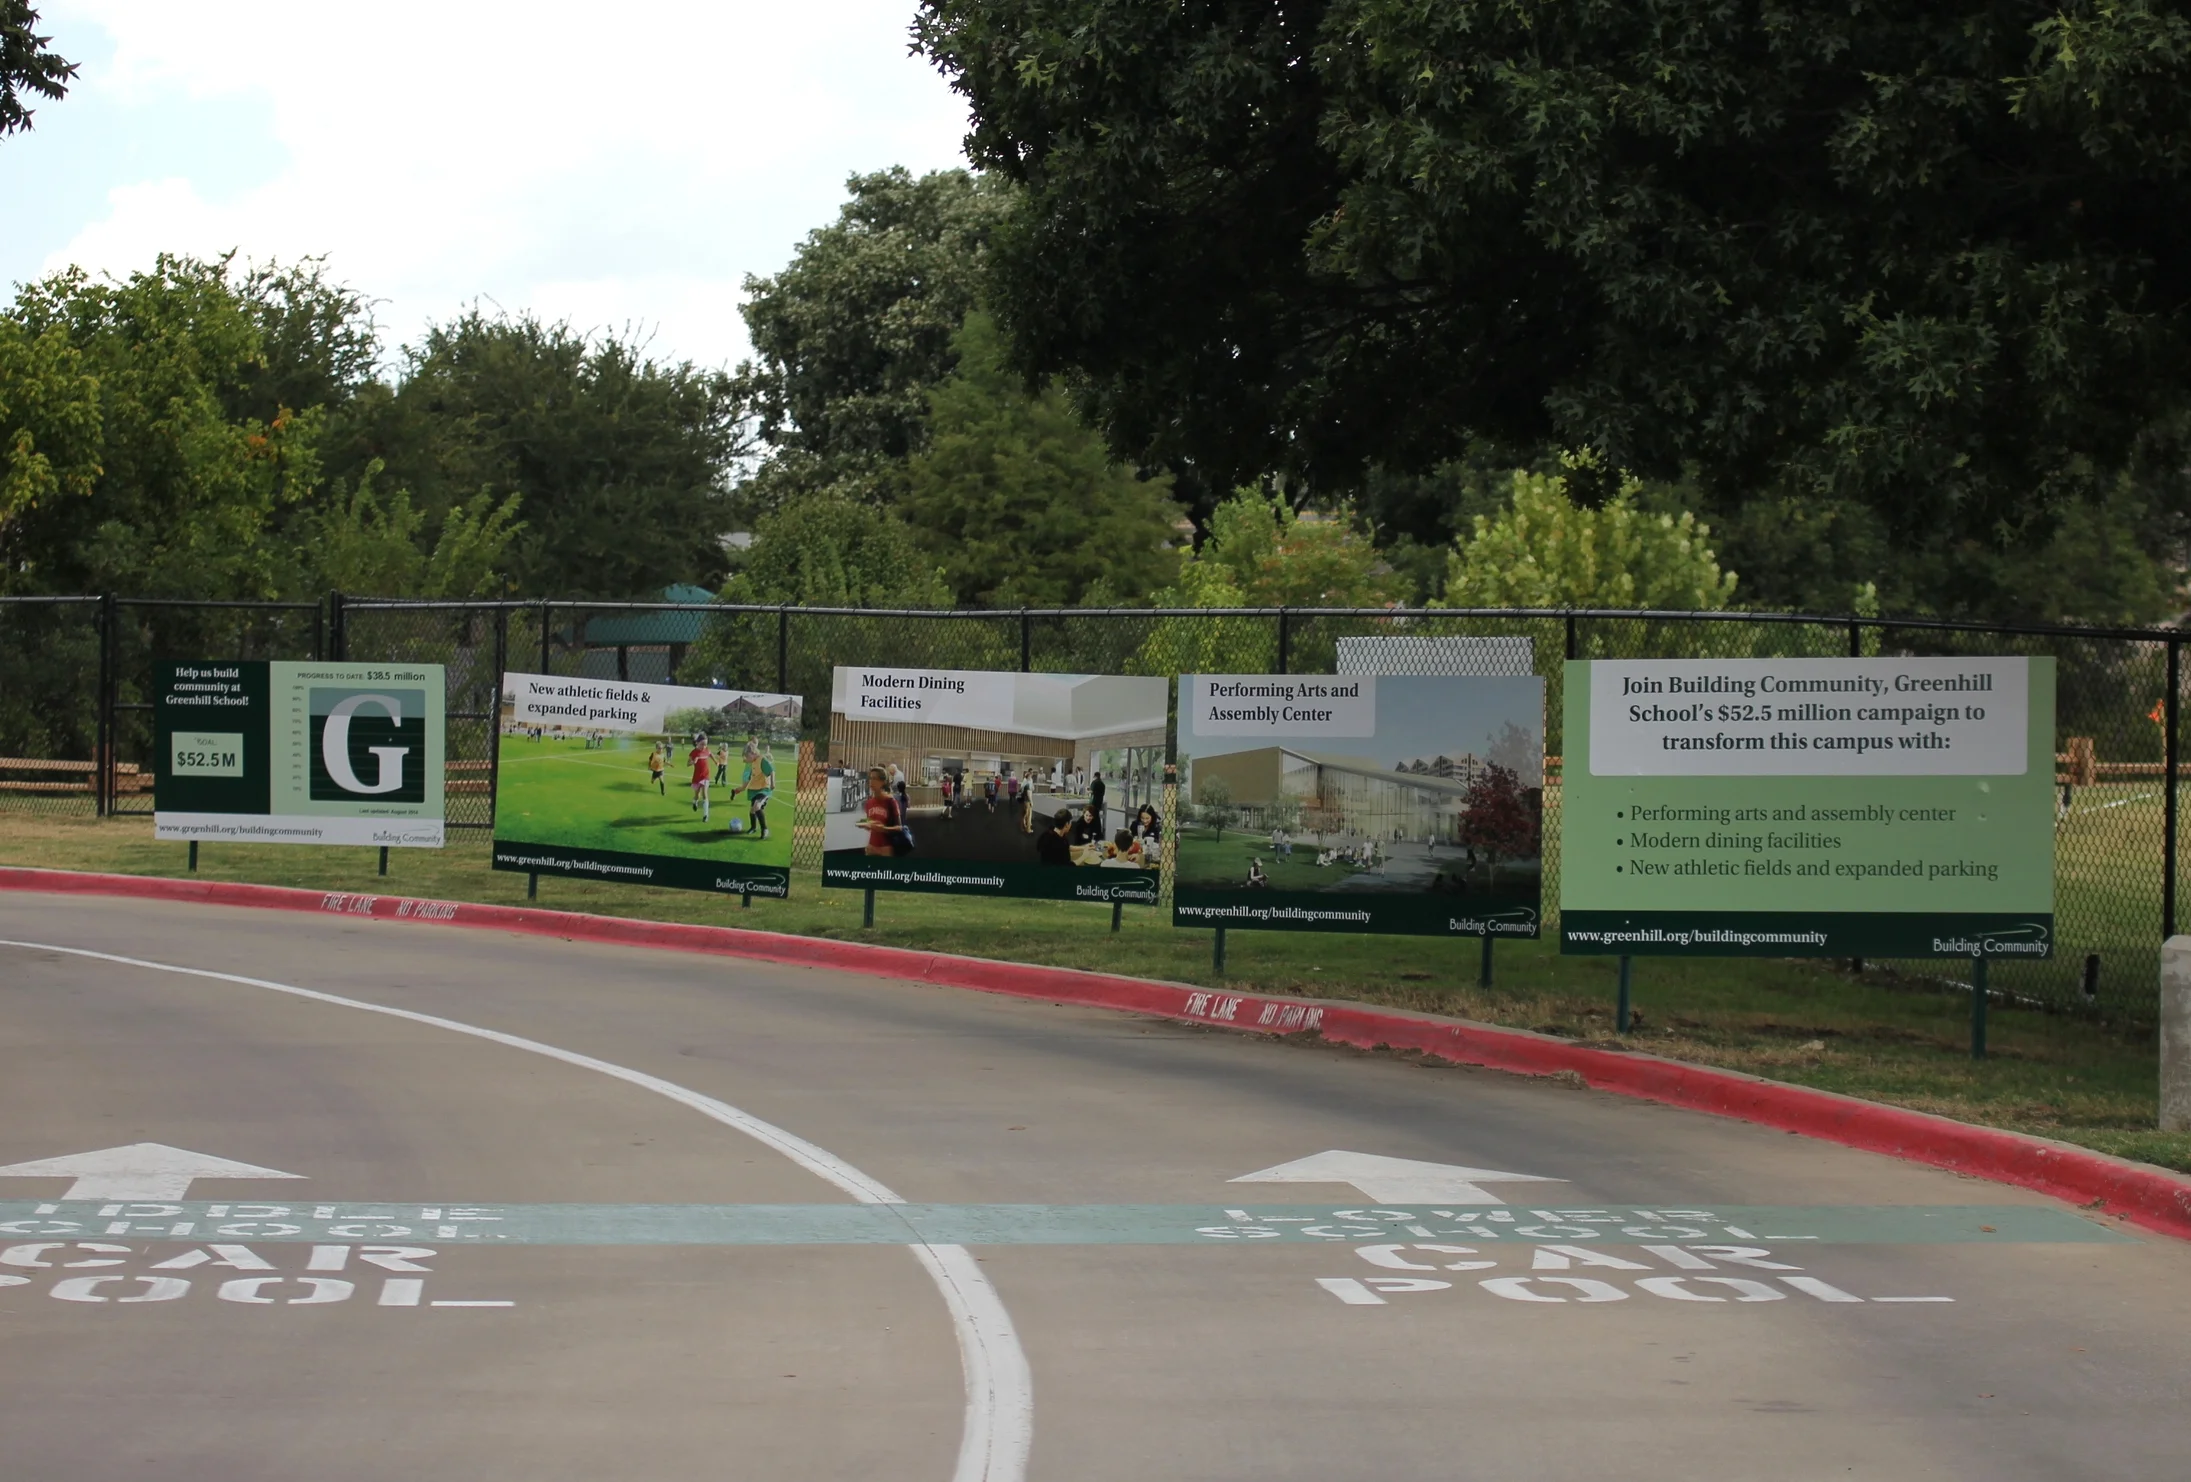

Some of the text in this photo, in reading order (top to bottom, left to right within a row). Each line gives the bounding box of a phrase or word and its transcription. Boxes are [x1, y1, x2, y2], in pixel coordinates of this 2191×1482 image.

[175, 667, 239, 680] Help us build
[367, 671, 391, 681] $38.5
[394, 672, 426, 681] million
[862, 674, 965, 693] Modern Dining
[173, 682, 241, 694] community at
[528, 682, 651, 703] New athletic fields &
[1209, 682, 1360, 701] Performing Arts and
[1622, 673, 1994, 698] Join Building Community, Greenhill
[165, 694, 249, 706] Greenhill School!
[860, 695, 922, 710] Facilities
[528, 702, 638, 724] expanded parking
[1208, 706, 1333, 724] Assembly Center
[1717, 703, 1773, 724] $52.5
[1776, 703, 1852, 722] million
[1856, 705, 1960, 727] campaign
[1964, 705, 1986, 721] to
[322, 694, 410, 794] G
[1661, 731, 1952, 755] transform this campus with:
[1630, 804, 1957, 825] Performing arts and assembly center
[159, 825, 324, 838] www.greenhill.org/buildingcommunity
[372, 832, 441, 845] Building Community
[1630, 831, 1842, 853] Modern dining facilities
[496, 854, 654, 877] www.greenhill.org/buildingcommunity
[1629, 859, 1999, 882] New athletic fields and expanded parking
[716, 878, 786, 897] Building Community
[827, 868, 1005, 888] www.greenhill.org/buildingcommunity
[1076, 884, 1156, 903] Building Community
[321, 894, 378, 915] FIRE LANE
[395, 900, 459, 920] NO PARKING
[1178, 904, 1372, 922] www.greenhill.org/buildingcommunity
[1450, 917, 1538, 937] Building Community
[1567, 926, 1828, 945] www.greenhill.org/buildingcommunity
[1932, 937, 2049, 956] Building Community
[1184, 992, 1244, 1021] FIRE LANE
[1257, 1003, 1278, 1025] NO
[1223, 1209, 1731, 1223] LOWER
[1194, 1225, 1820, 1240] SCHOOL
[0, 1243, 438, 1272] CAR
[1354, 1244, 1806, 1271] CAR
[0, 1275, 516, 1307] OOL
[1313, 1276, 1957, 1304] POOL
